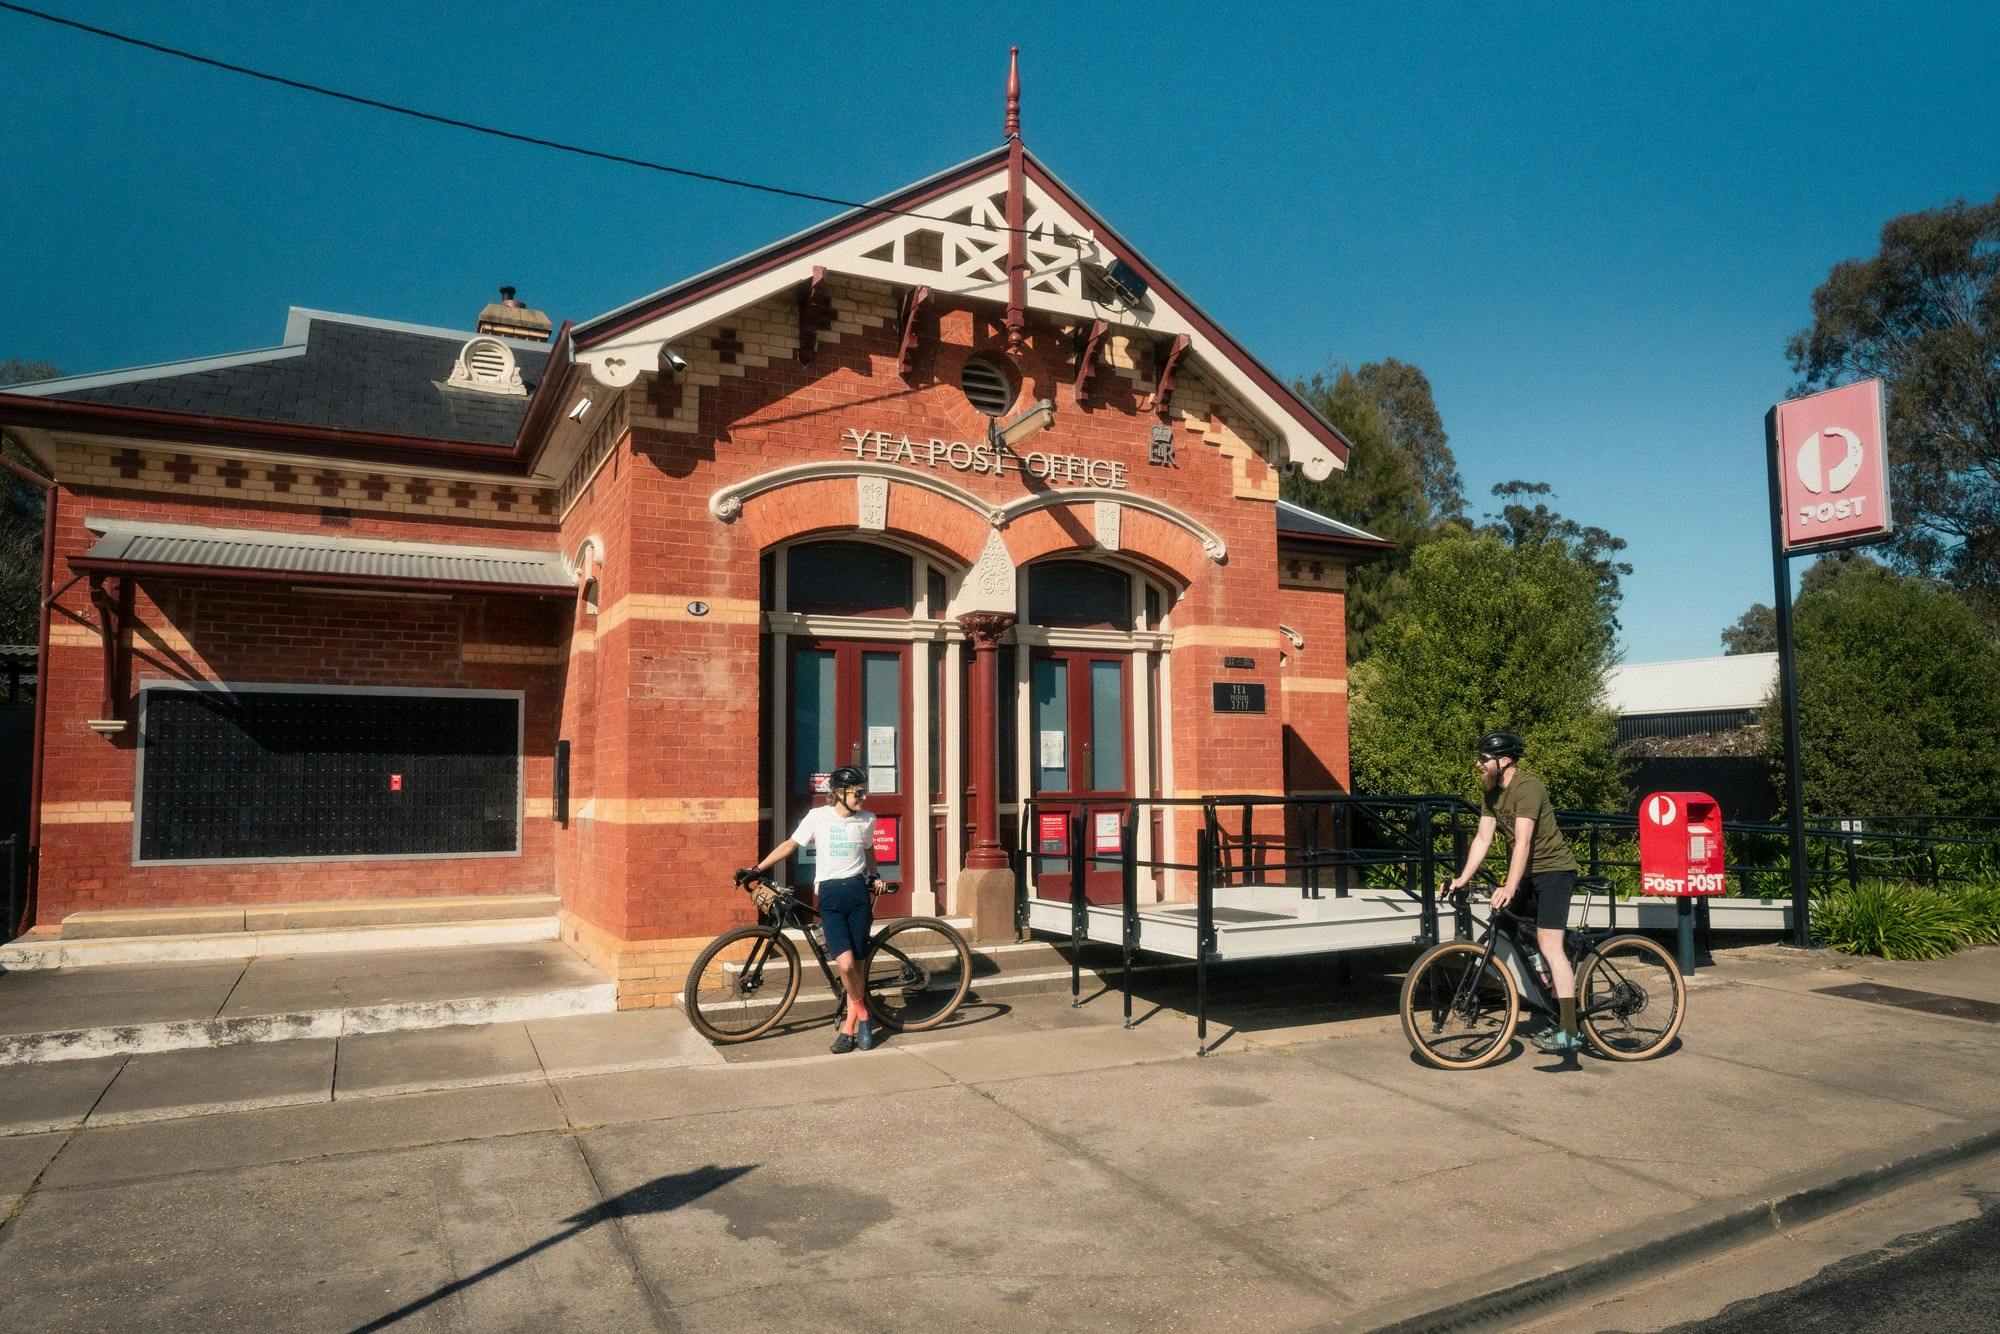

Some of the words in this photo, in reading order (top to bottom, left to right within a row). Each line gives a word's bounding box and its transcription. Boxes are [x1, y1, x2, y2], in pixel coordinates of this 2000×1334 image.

[849, 428, 918, 465] YEA
[928, 438, 1007, 475] POST
[1025, 451, 1127, 489] OFFICE
[1800, 496, 1866, 526] POST
[1232, 685, 1246, 694] YEA
[1231, 700, 1249, 710] 3717
[1644, 877, 1685, 892] POST
[1687, 873, 1724, 892] POST
